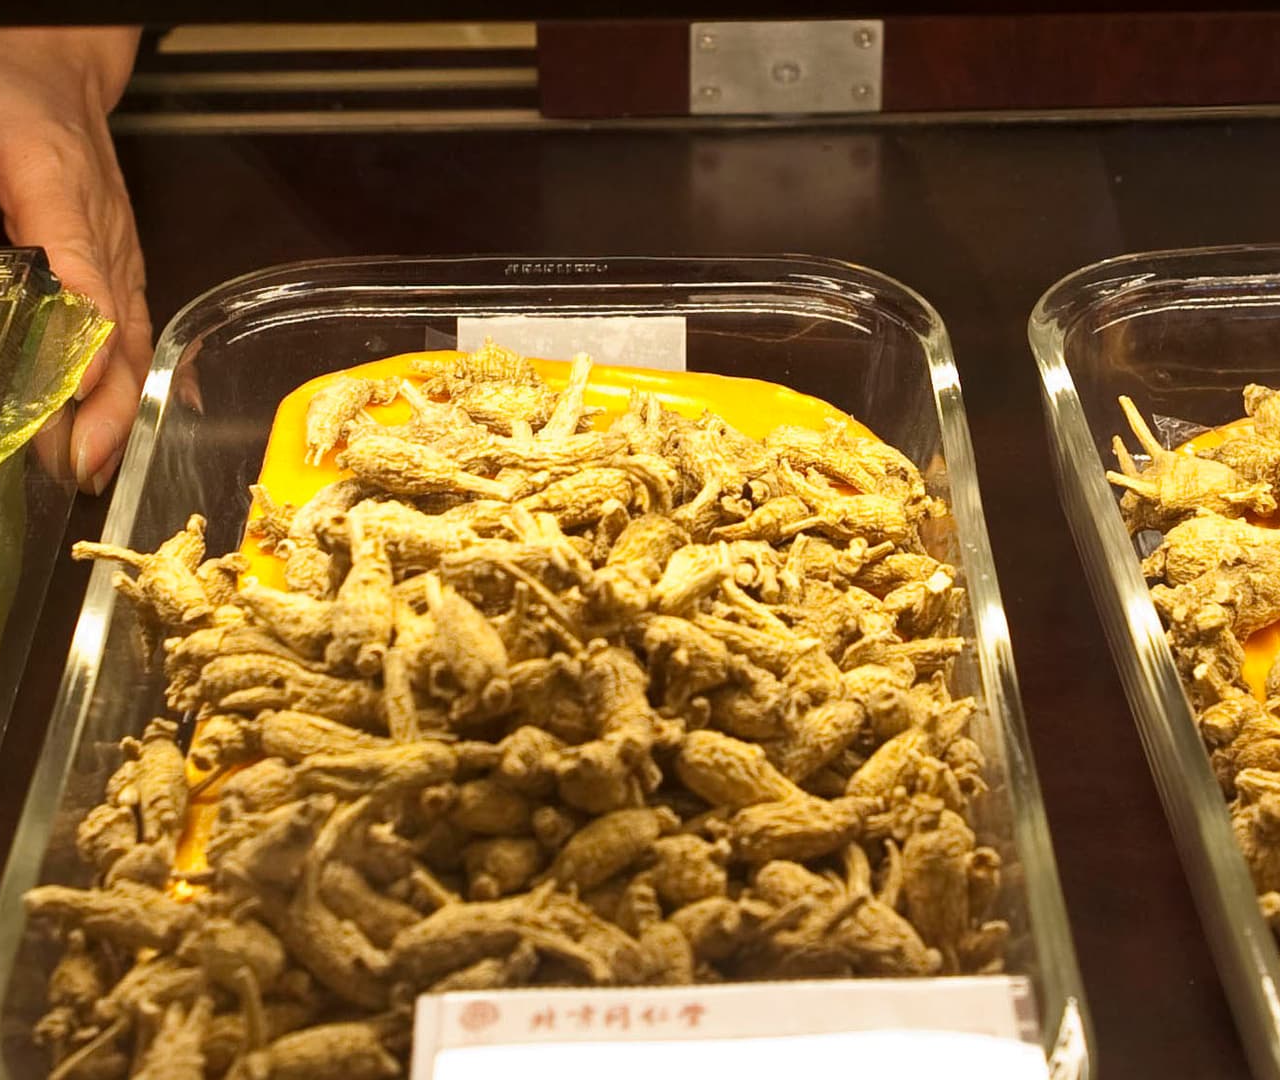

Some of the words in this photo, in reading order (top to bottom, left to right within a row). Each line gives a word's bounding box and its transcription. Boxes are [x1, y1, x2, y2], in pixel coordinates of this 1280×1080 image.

[531, 1004, 706, 1030] 北京同仁堂
